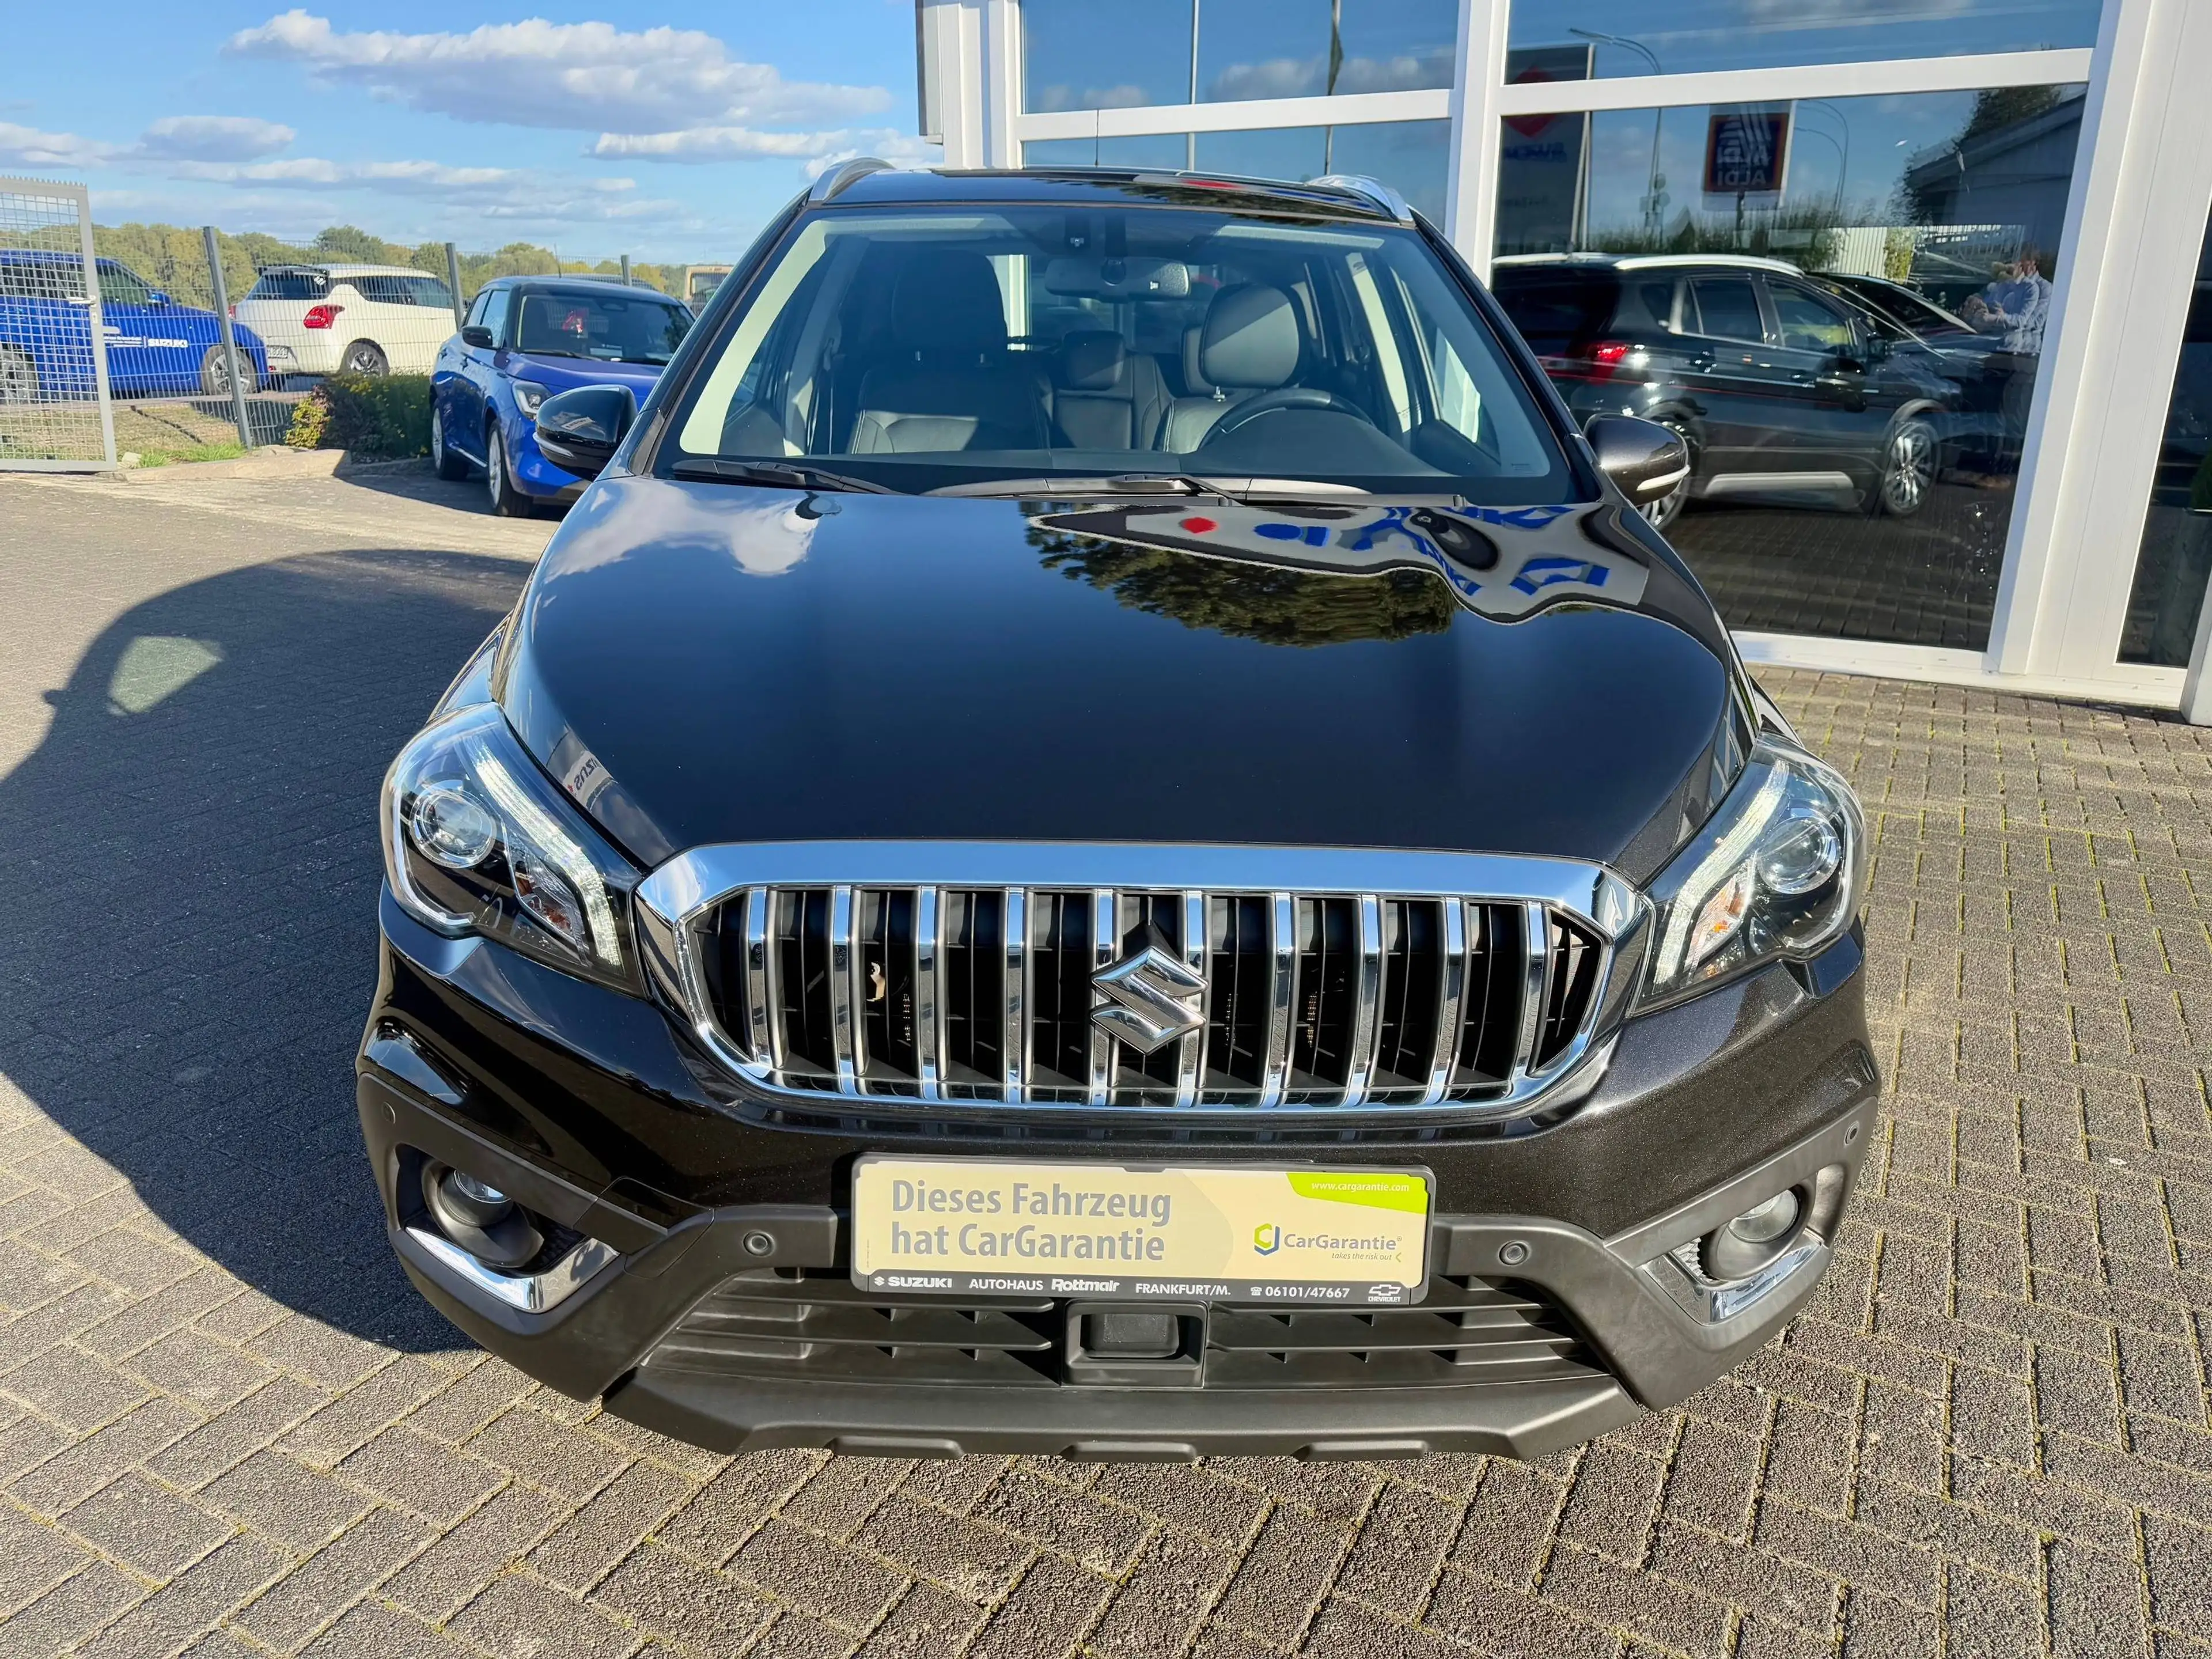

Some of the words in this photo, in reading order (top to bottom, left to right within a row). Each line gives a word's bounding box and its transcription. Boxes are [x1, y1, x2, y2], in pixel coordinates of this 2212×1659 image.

[1312, 1182, 1410, 1192] www.cargarantie.com
[892, 1180, 1001, 1214] Dieses
[1012, 1183, 1171, 1227] Fahrzeug
[891, 1221, 949, 1255] hat
[959, 1223, 1165, 1261] CarGarantie
[888, 1277, 952, 1288] SUZUKI
[969, 1278, 1043, 1290] AUTOHAUS
[1051, 1278, 1120, 1292] Rottmair
[1135, 1283, 1231, 1296] FRANKFURT/M.
[1265, 1286, 1350, 1298] 06101/47667
